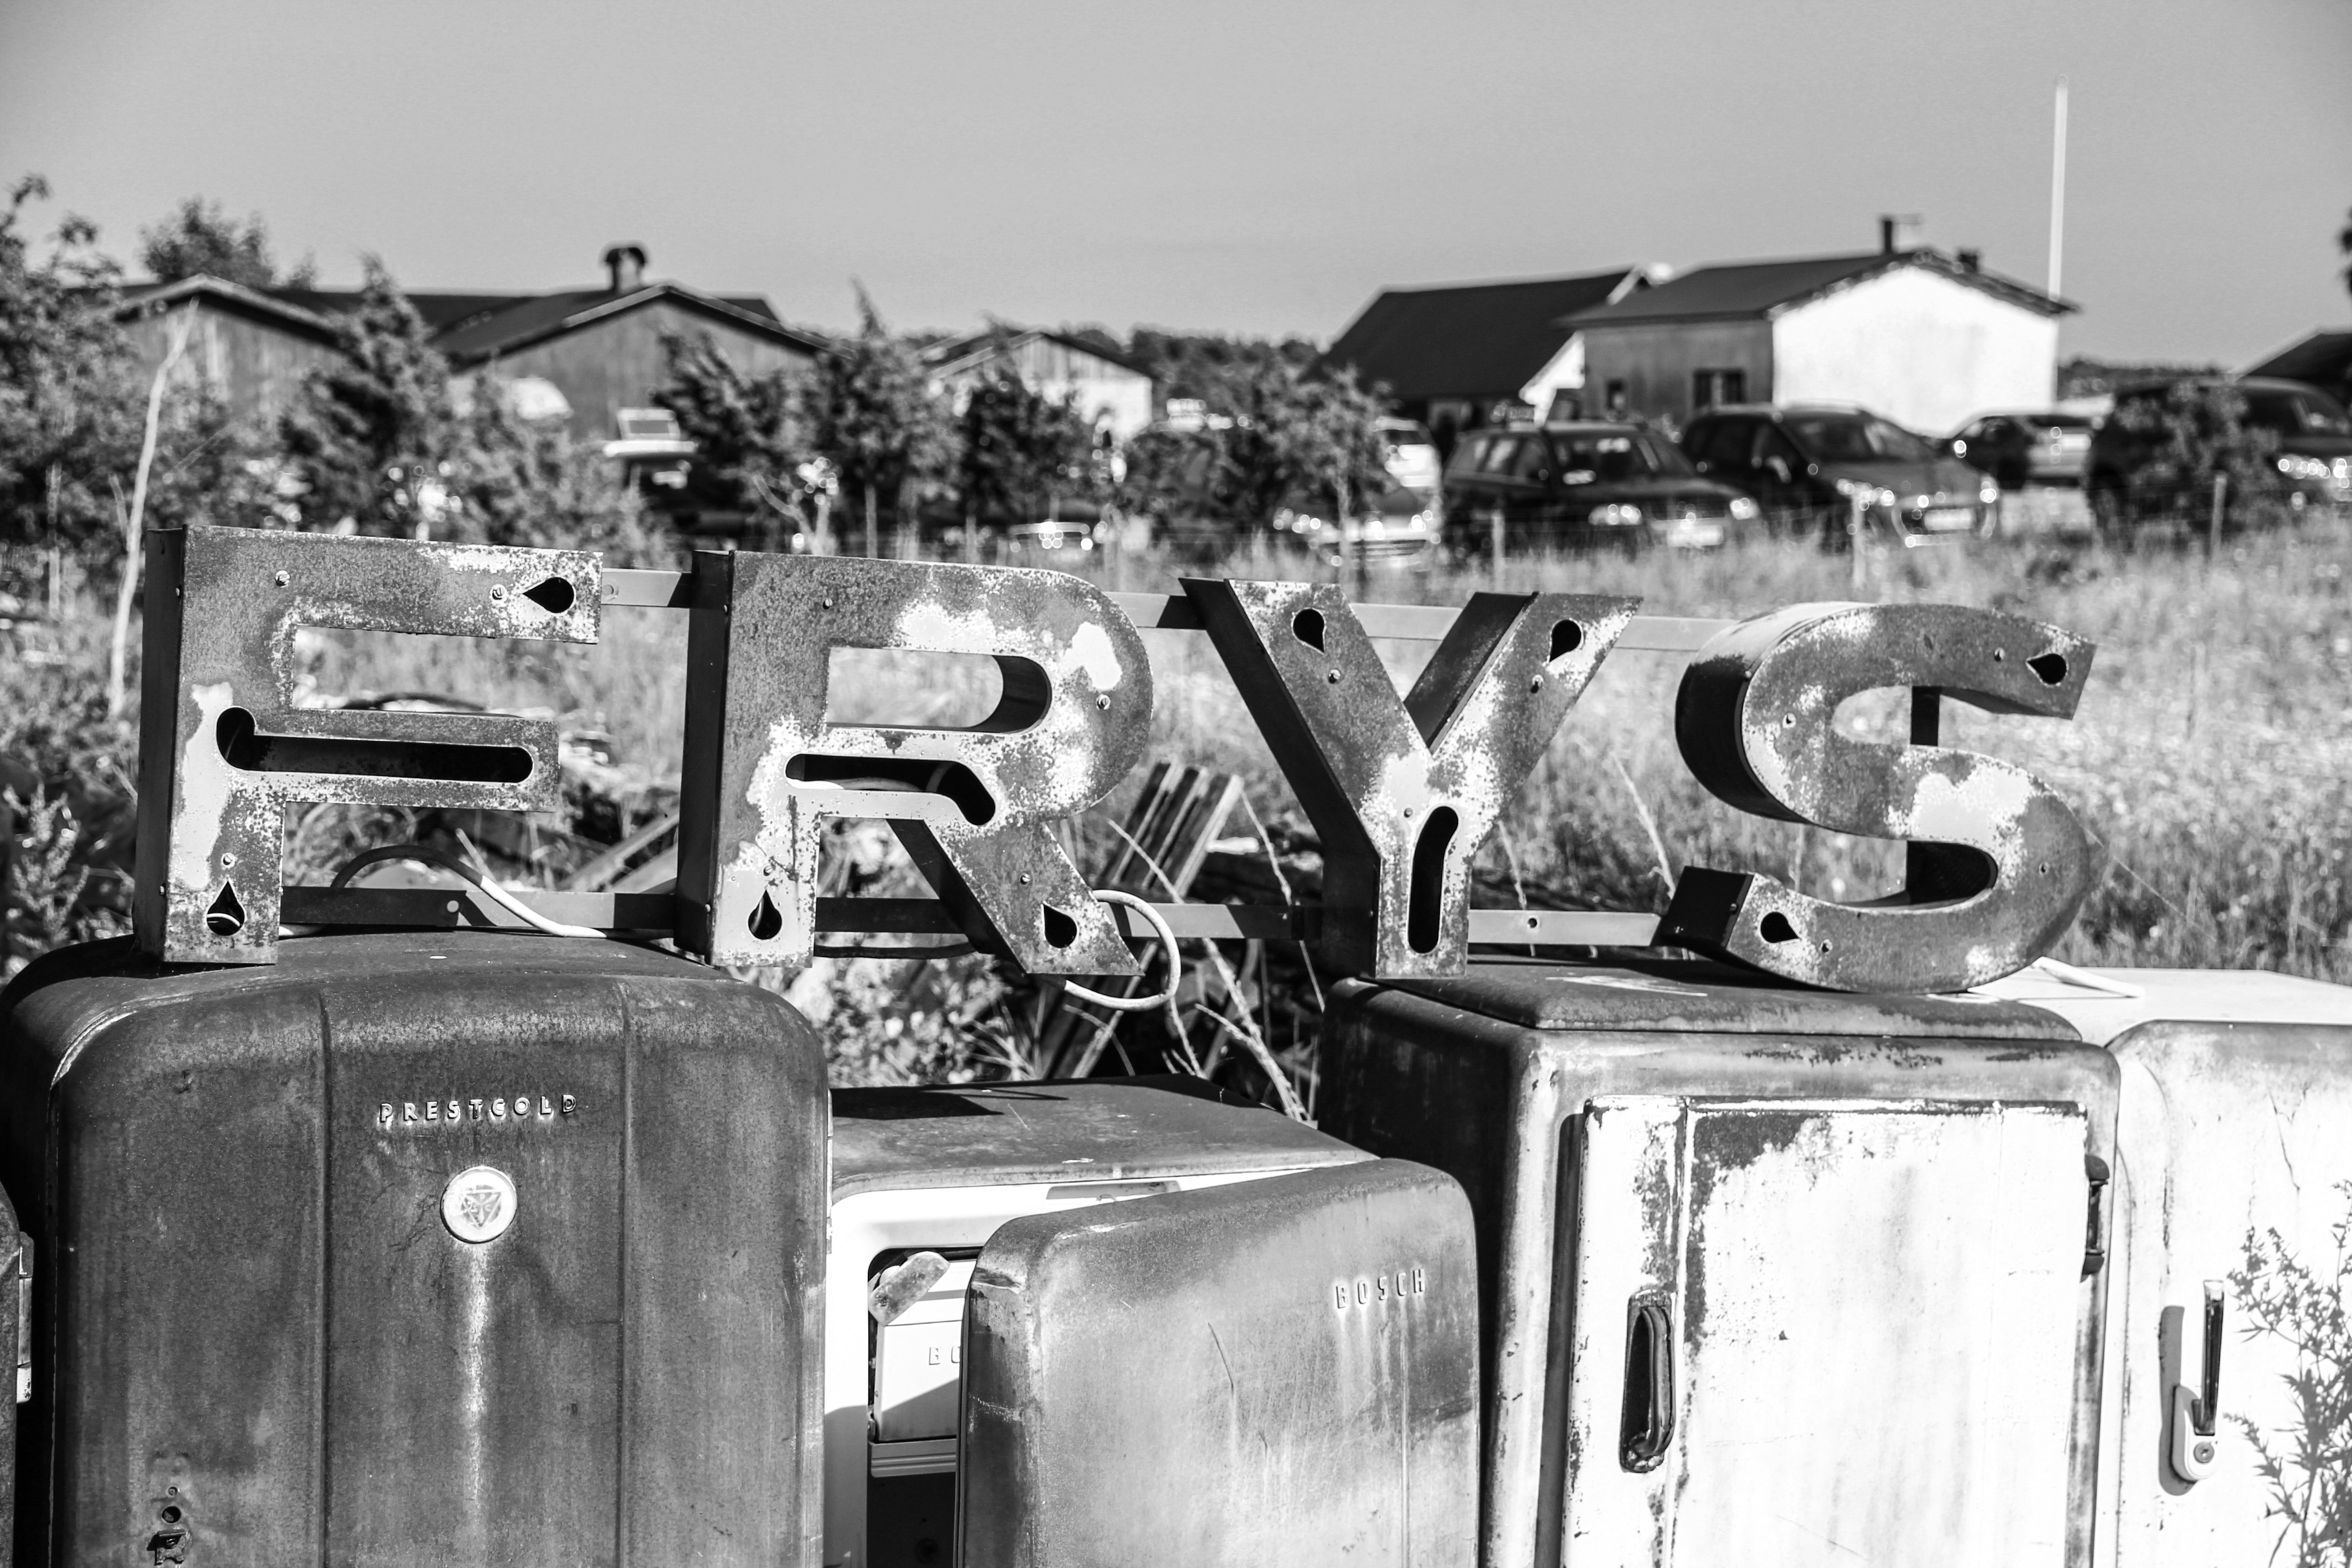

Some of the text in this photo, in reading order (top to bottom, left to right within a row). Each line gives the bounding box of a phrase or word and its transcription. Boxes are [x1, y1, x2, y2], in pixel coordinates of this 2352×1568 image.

[144, 524, 2097, 994] FRYS
[379, 1094, 577, 1122] PRESTCOLD
[1336, 1269, 1425, 1308] BOSCH
